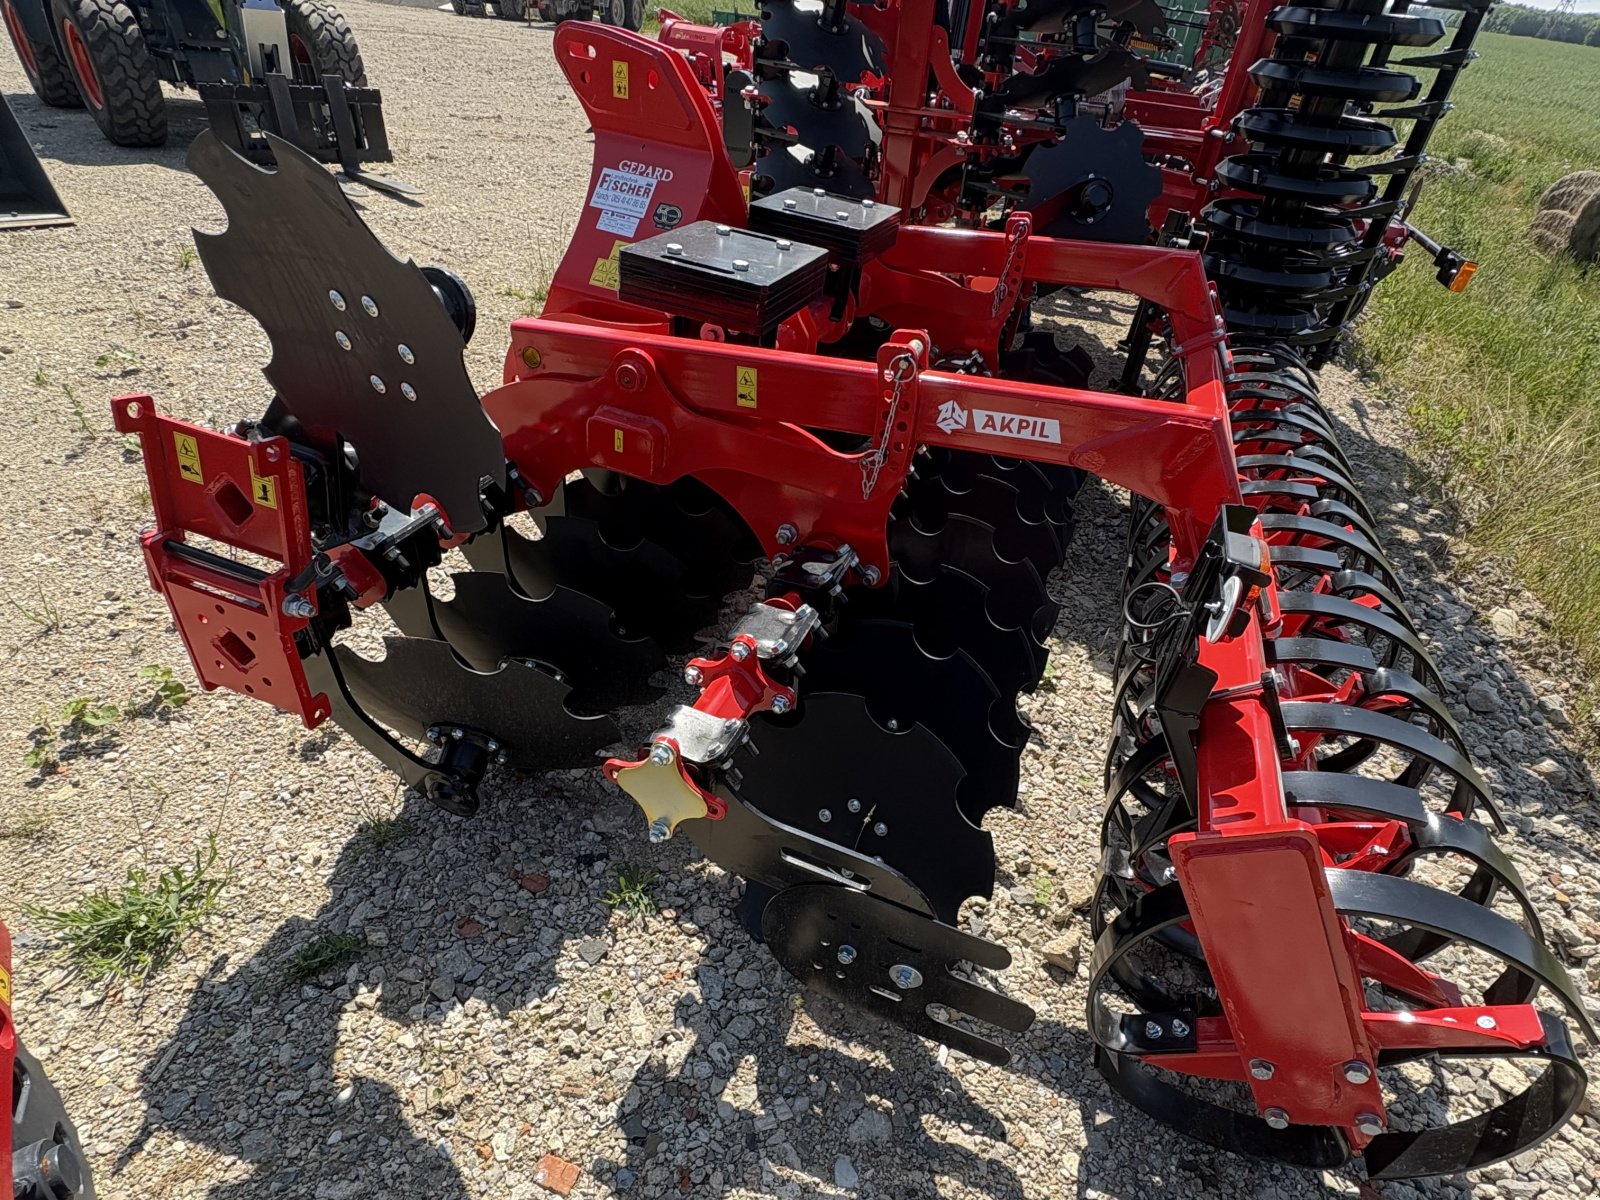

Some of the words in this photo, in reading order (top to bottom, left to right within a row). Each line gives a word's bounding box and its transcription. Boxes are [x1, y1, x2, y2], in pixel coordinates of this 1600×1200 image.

[618, 160, 674, 182] GEPARD
[599, 173, 652, 199] FISCHER
[981, 414, 1050, 439] AKPIL
